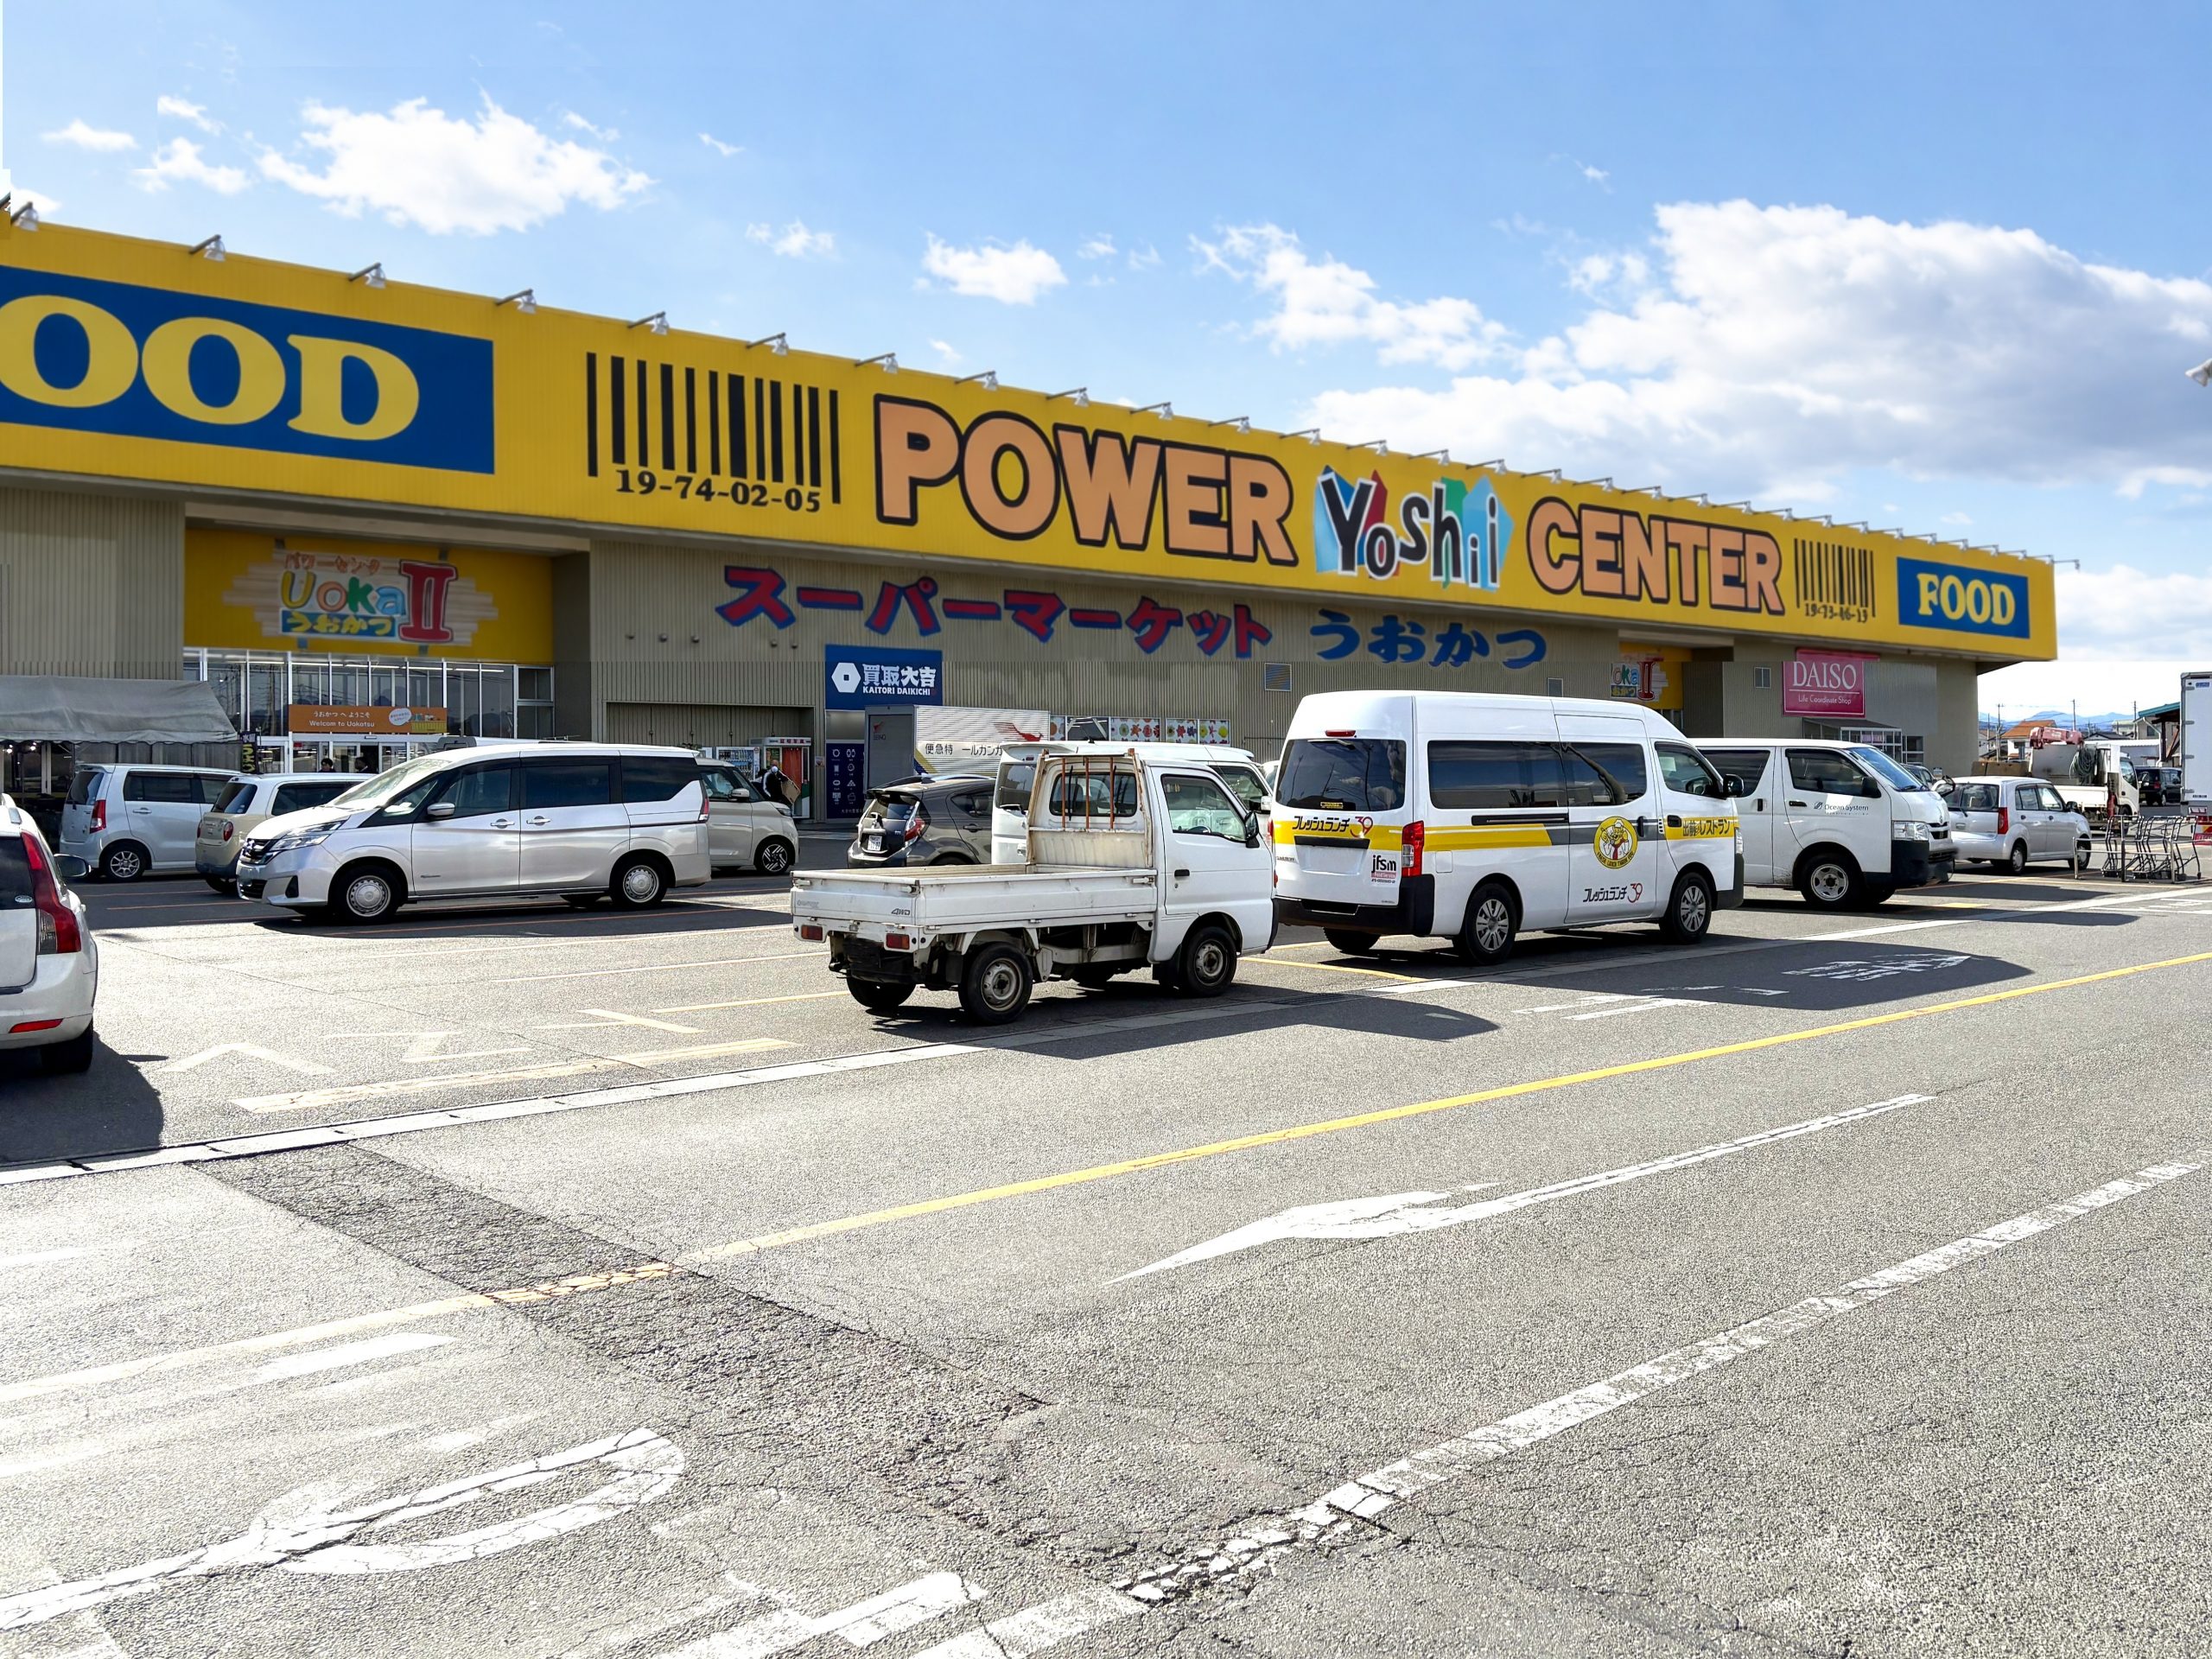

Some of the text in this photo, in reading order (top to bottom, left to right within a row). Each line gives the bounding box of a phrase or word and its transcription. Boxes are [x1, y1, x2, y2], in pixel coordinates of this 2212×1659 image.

[615, 469, 821, 512] 19-74-02-05
[874, 393, 1786, 616] POWER Yoshii CENTER
[1916, 572, 2016, 626] FOOD
[286, 611, 392, 637] うおかつ
[715, 564, 1547, 669] スーパーマーケット うおかつ
[862, 664, 936, 688] 買取大吉
[1792, 661, 1857, 690] DAISO
[862, 686, 895, 695] KAITORI
[1798, 694, 1852, 705] Life Coordinate Shop
[1845, 804, 1869, 812] System
